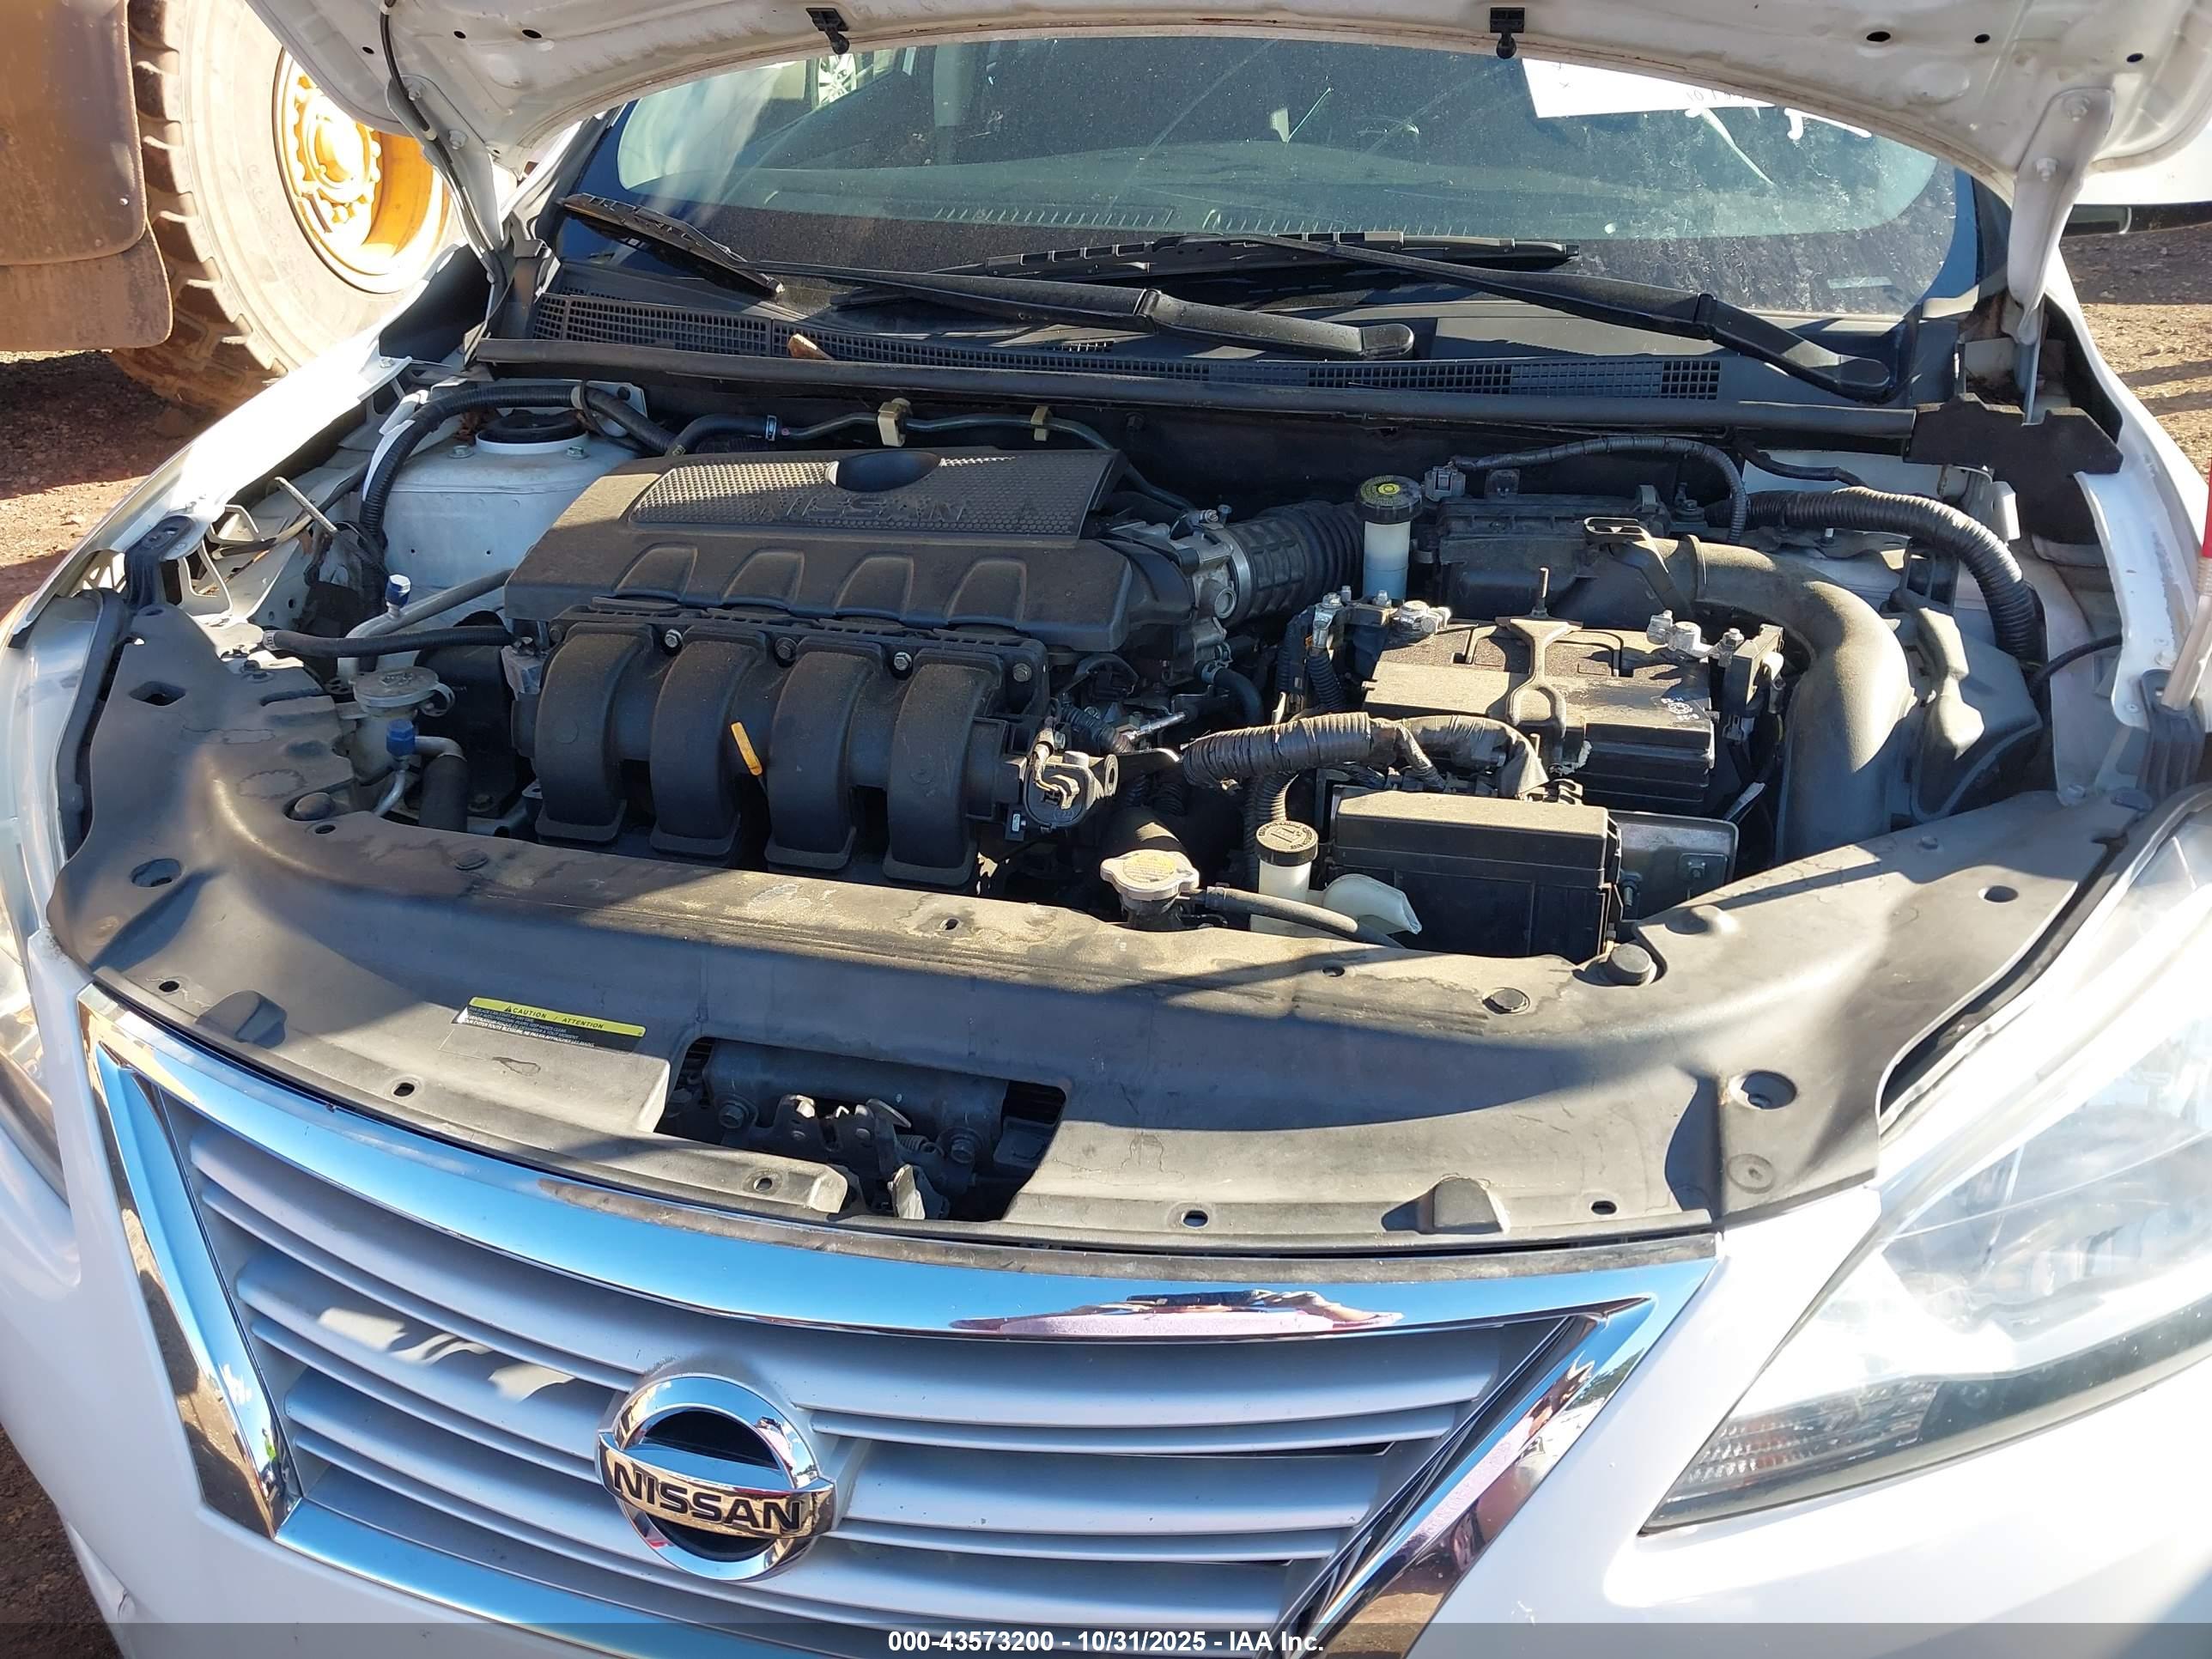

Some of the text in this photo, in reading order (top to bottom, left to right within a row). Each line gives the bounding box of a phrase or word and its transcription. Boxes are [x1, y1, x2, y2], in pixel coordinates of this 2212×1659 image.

[513, 1006, 547, 1018] CAUTION
[562, 1018, 605, 1029] ATTENTION
[613, 1462, 802, 1531] NISSAN
